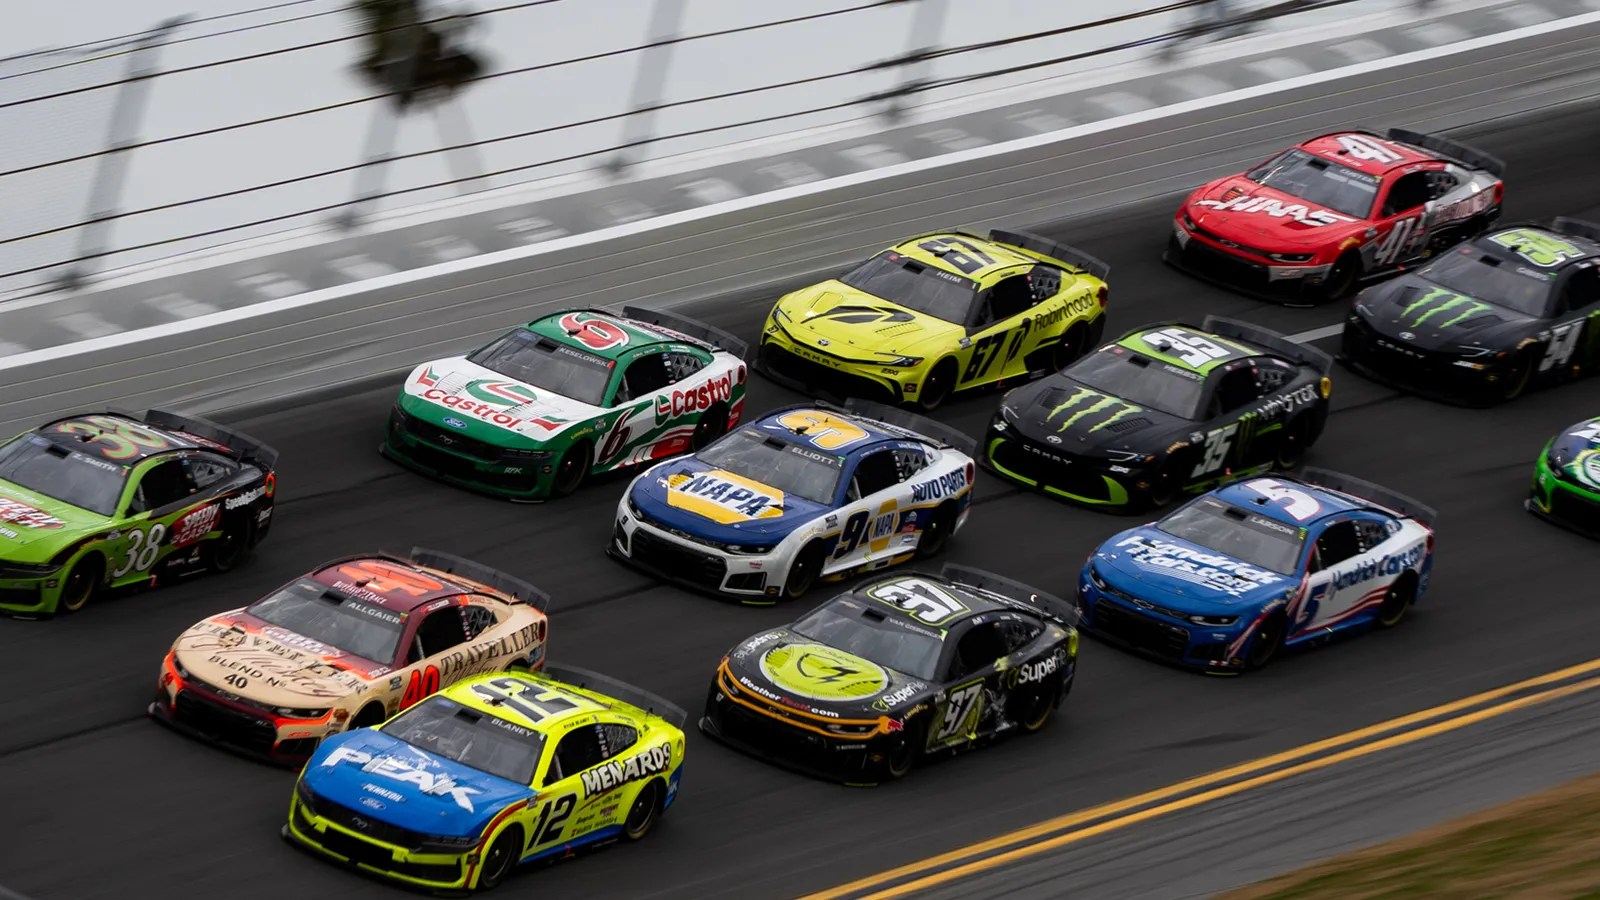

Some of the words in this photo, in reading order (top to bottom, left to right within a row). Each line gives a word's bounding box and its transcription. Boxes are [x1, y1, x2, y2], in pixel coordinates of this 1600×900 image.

[1335, 135, 1405, 163] 41
[1193, 195, 1358, 227] HAAS
[917, 236, 996, 275] 67
[1374, 216, 1417, 266] 41
[936, 271, 962, 284] HEIM
[1034, 288, 1095, 332] Robinhood
[558, 312, 631, 351] 6
[1141, 328, 1232, 369] 35
[794, 348, 842, 368] CAMRY
[960, 329, 1010, 384] 67
[672, 351, 733, 418] Castrol
[423, 387, 523, 429] Castrol
[57, 416, 169, 460] 38
[597, 407, 637, 466] 6
[776, 409, 871, 451] 9
[1190, 422, 1240, 478] 35
[84, 457, 117, 472] SMITH
[791, 446, 836, 466] ELLIOTT
[1023, 444, 1073, 466] CAMRY
[680, 474, 772, 517] NAPA
[911, 479, 941, 504] AUTO
[939, 467, 966, 498] PARTS
[1243, 478, 1324, 522] 5
[181, 503, 221, 533] SPEEDY
[832, 508, 871, 560] 9
[872, 512, 896, 538] NAPA
[1250, 516, 1296, 536] LARSON
[113, 523, 167, 579] 38
[339, 560, 444, 596] 40
[1081, 583, 1091, 593] 5
[347, 601, 401, 625] ALLGAIER
[874, 578, 968, 623] 97
[208, 655, 263, 680] BLEND
[440, 621, 541, 676] TRAVELLER
[224, 673, 249, 690] 40
[399, 664, 441, 710] 40
[471, 677, 581, 726] 12
[740, 676, 840, 719] WeatherTech.com
[491, 718, 534, 738] BLANEY
[937, 683, 985, 741] 97
[320, 746, 484, 815] PEAK
[580, 742, 672, 800] MENARDS
[363, 784, 405, 803] PENNZOIL
[526, 792, 579, 852] 12
